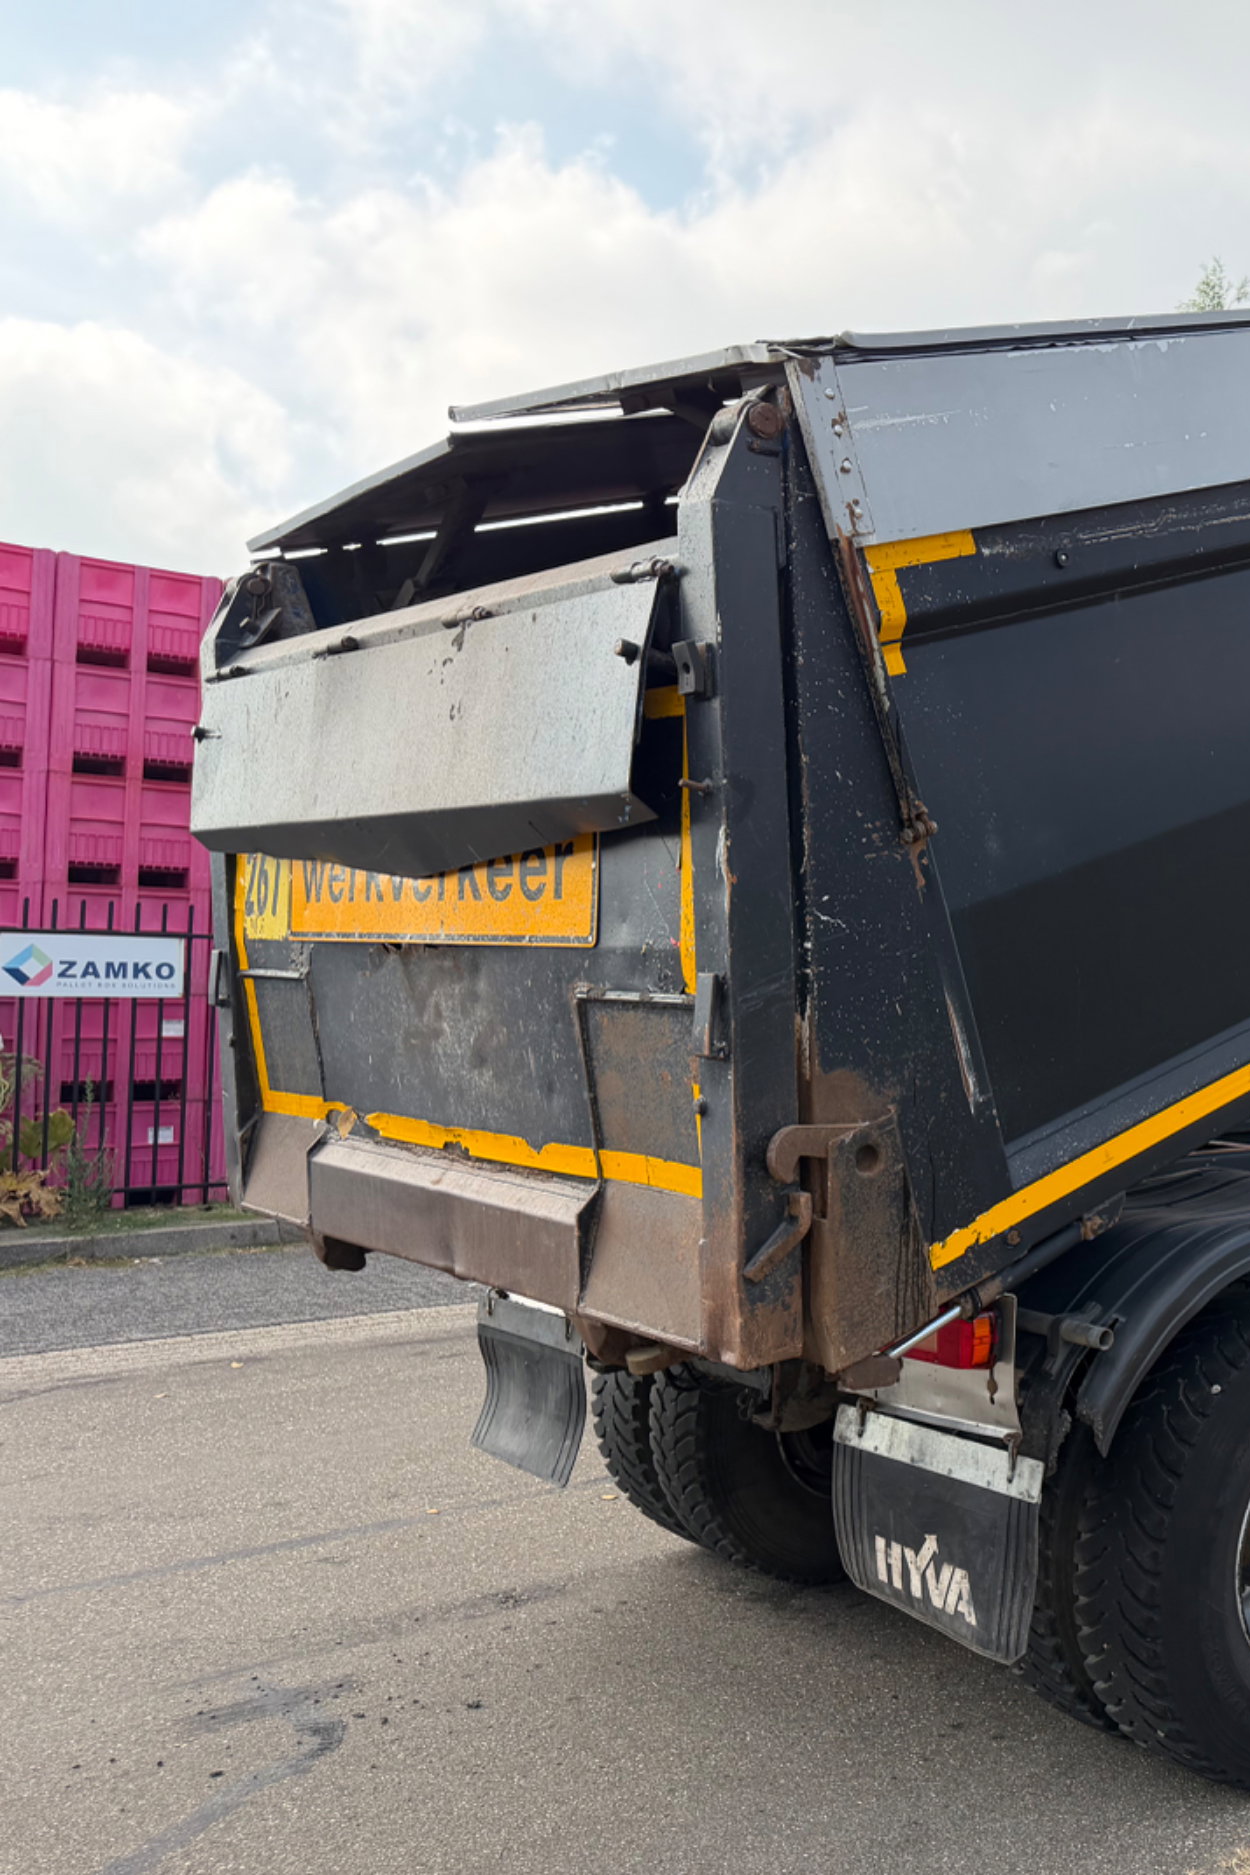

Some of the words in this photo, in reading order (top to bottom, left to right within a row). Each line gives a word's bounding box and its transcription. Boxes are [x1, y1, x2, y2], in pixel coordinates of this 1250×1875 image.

[56, 960, 176, 980] ZAMKO
[121, 982, 176, 990] SOLUTIONS
[874, 1533, 977, 1627] HYVA
